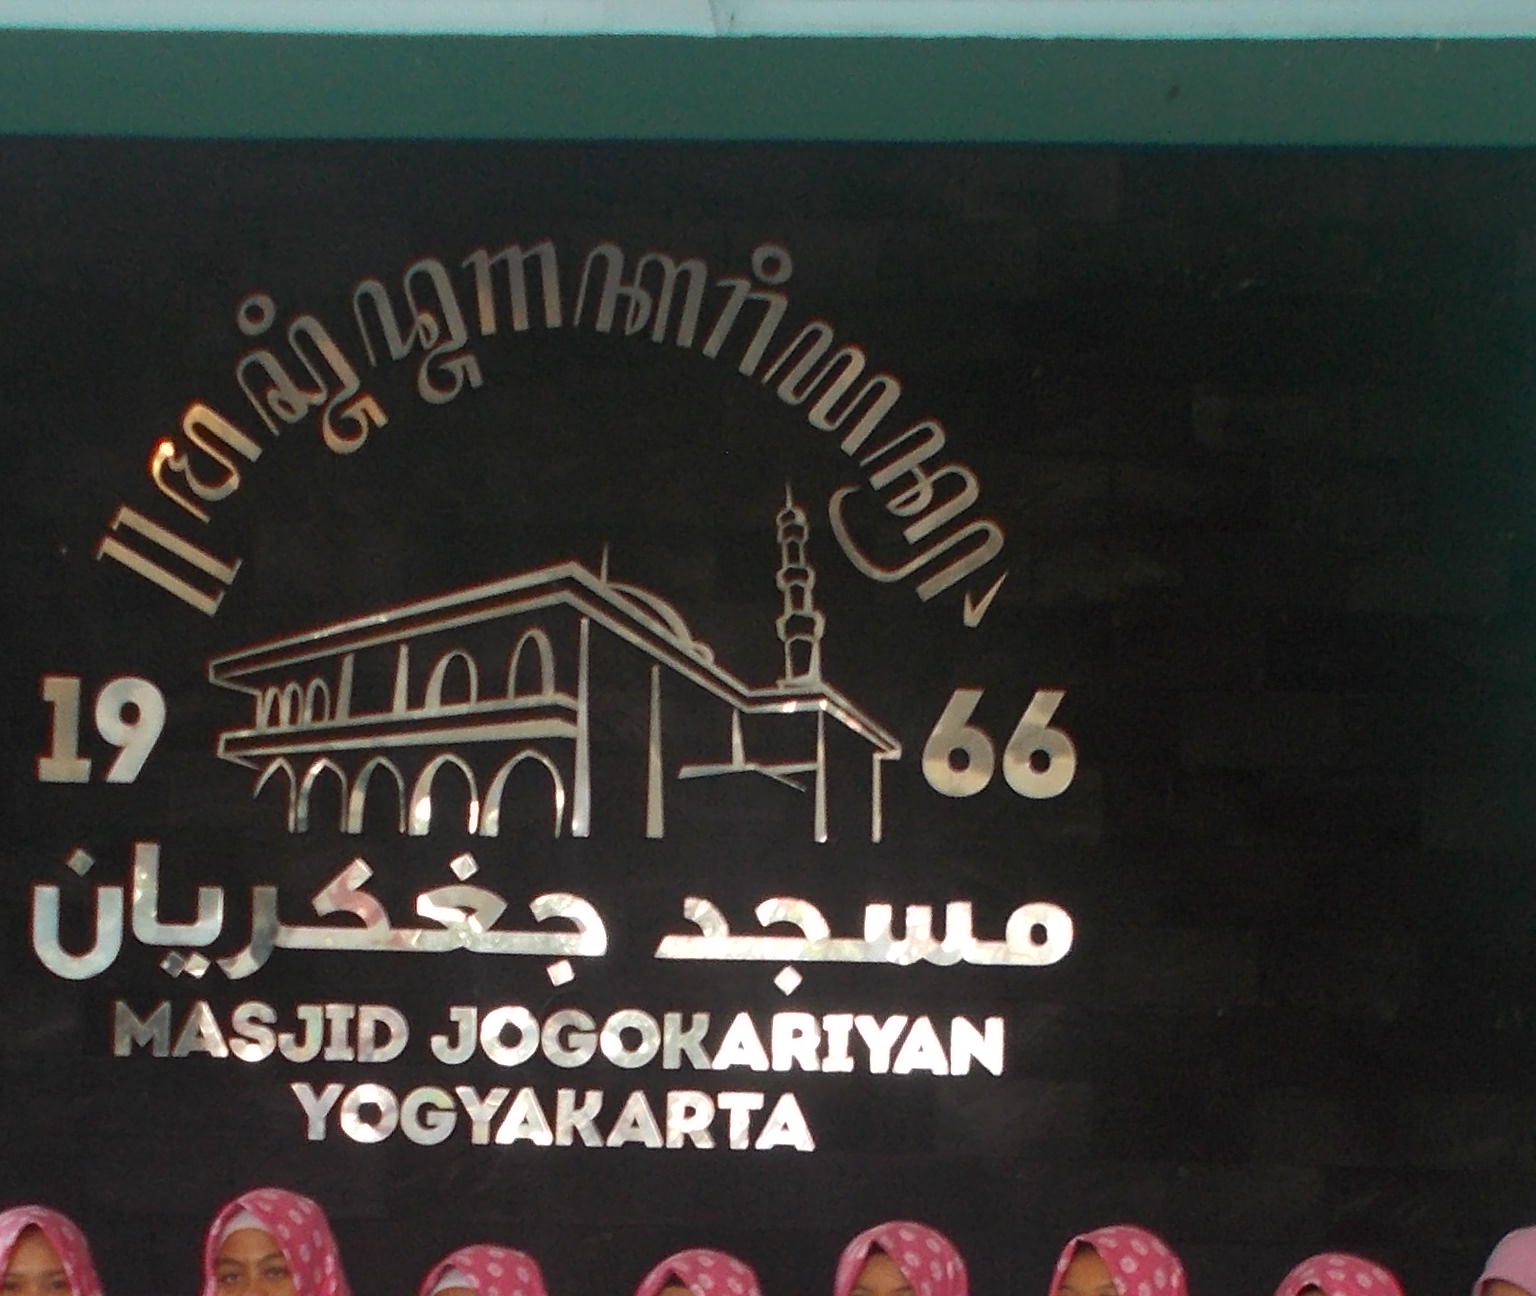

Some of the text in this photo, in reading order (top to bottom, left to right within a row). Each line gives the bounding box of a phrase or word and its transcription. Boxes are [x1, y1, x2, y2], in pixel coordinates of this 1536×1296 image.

[36, 675, 168, 784] 19
[921, 687, 1079, 800] 66
[653, 894, 1077, 996] مسجد
[113, 999, 1007, 1079] MASJID JOGOKARIYAN
[289, 1080, 817, 1154] YOGYAKARTA
